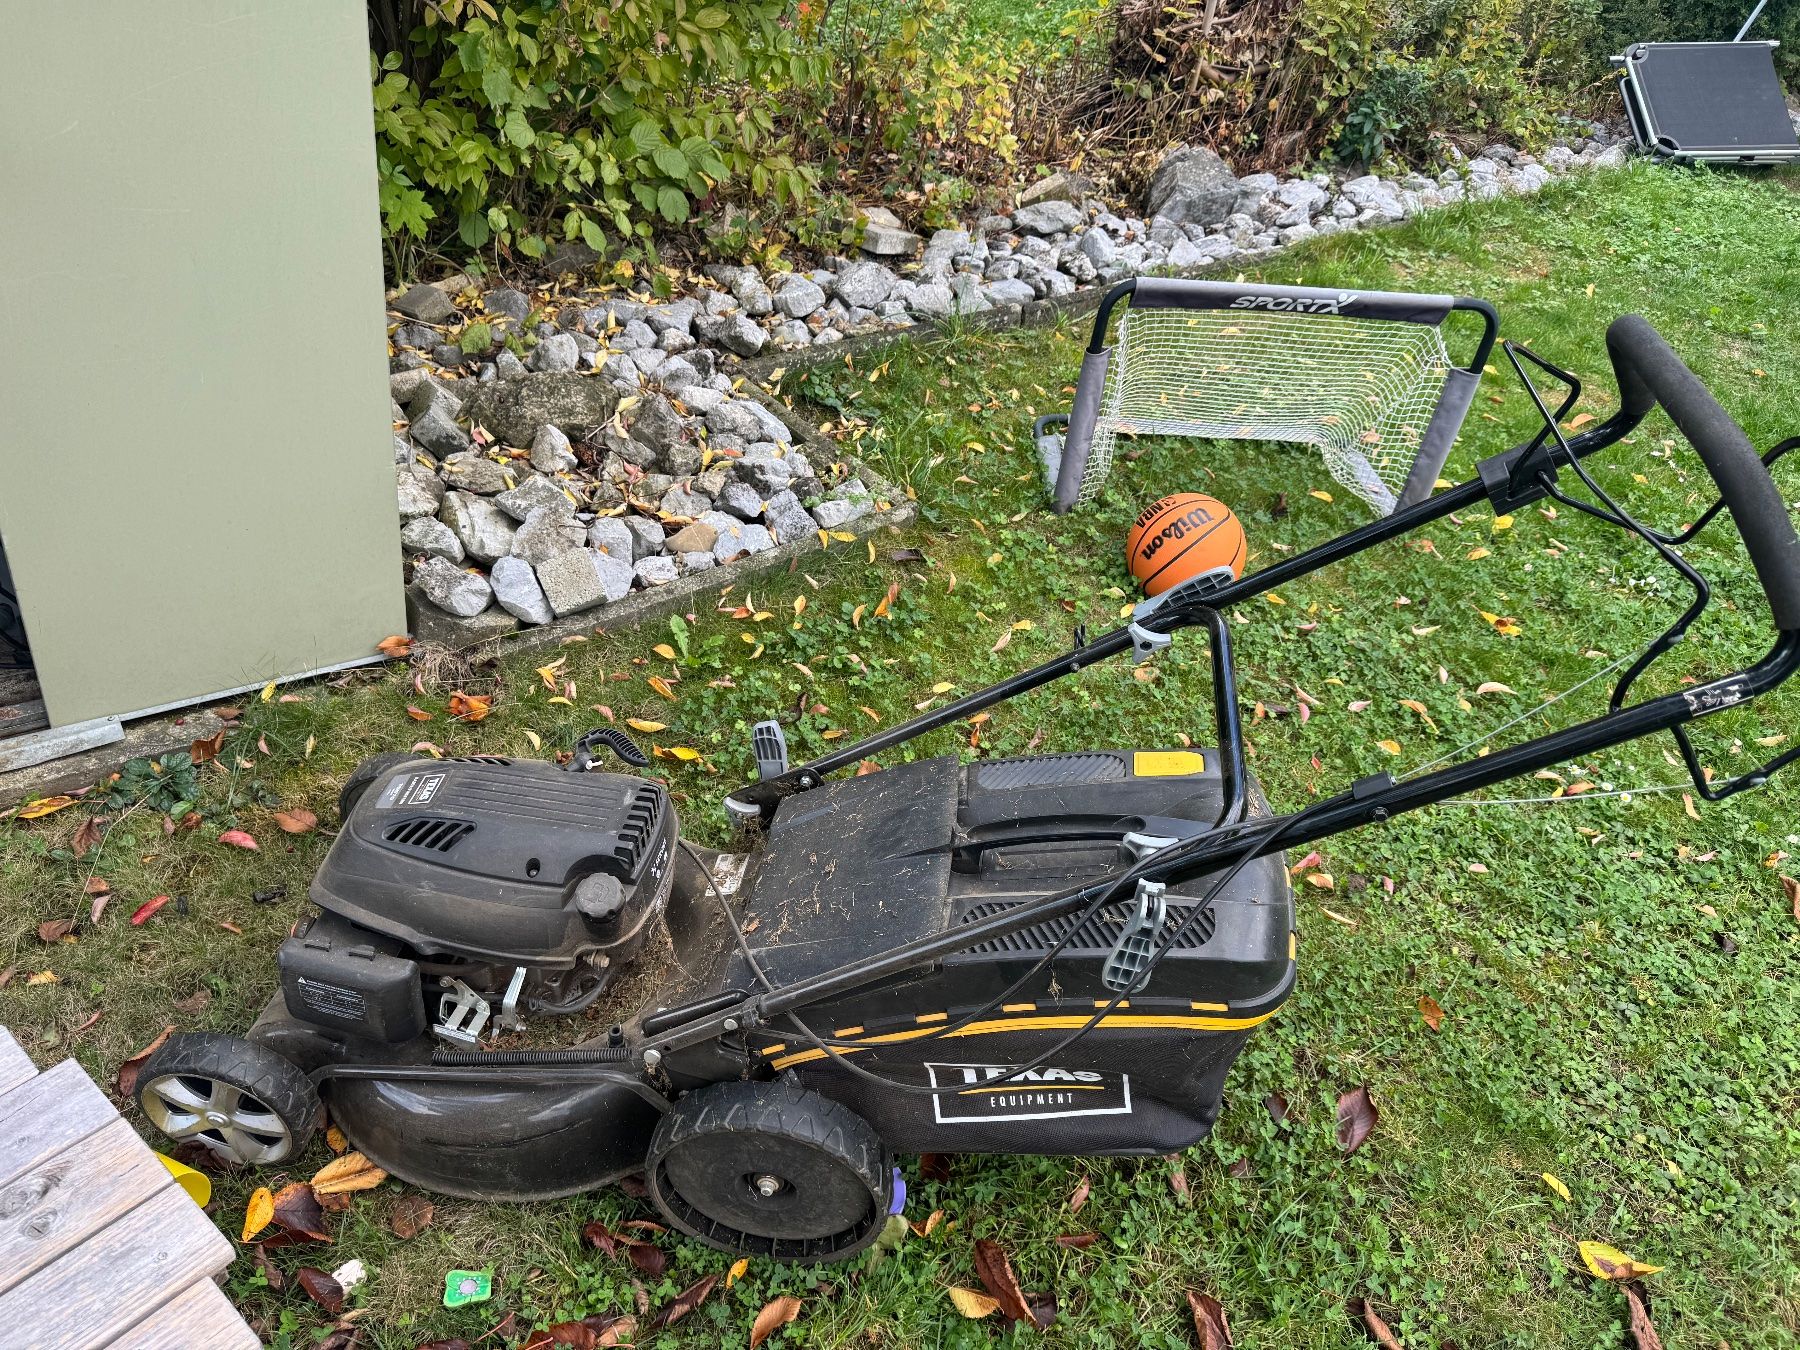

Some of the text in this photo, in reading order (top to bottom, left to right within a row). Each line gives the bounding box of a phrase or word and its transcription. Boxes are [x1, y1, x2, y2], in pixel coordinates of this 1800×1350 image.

[1229, 292, 1359, 315] SPORTX
[1135, 502, 1165, 529] NBA
[1141, 507, 1214, 560] Wilson
[990, 1092, 1073, 1108] EQUIPMENT
